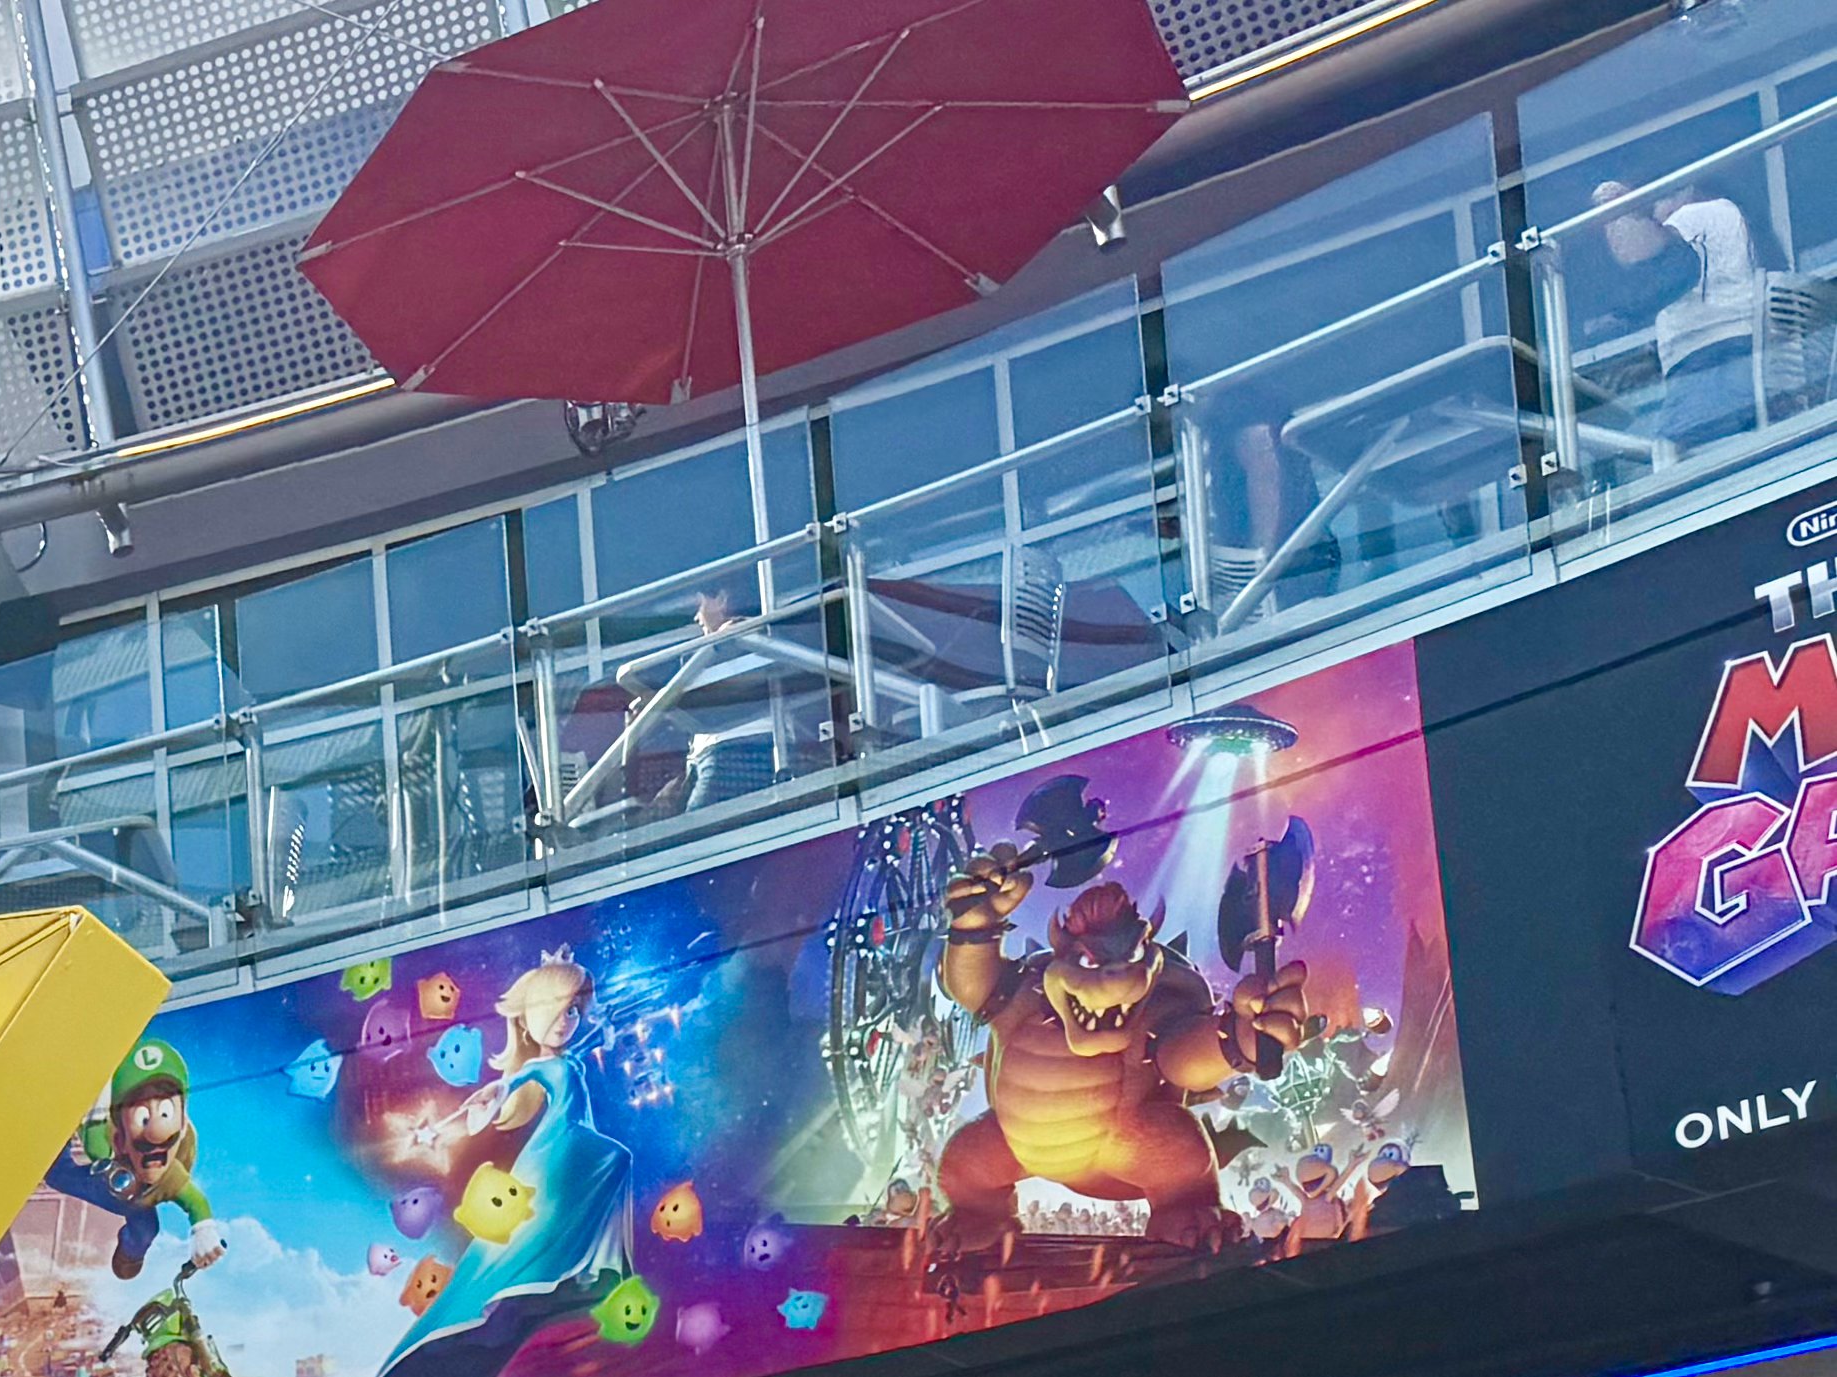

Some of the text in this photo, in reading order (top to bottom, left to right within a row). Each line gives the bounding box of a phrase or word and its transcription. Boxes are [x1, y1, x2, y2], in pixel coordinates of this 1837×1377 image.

[1754, 557, 1837, 633] TH
[142, 1049, 158, 1066] L
[1675, 1080, 1817, 1149] ONLY
